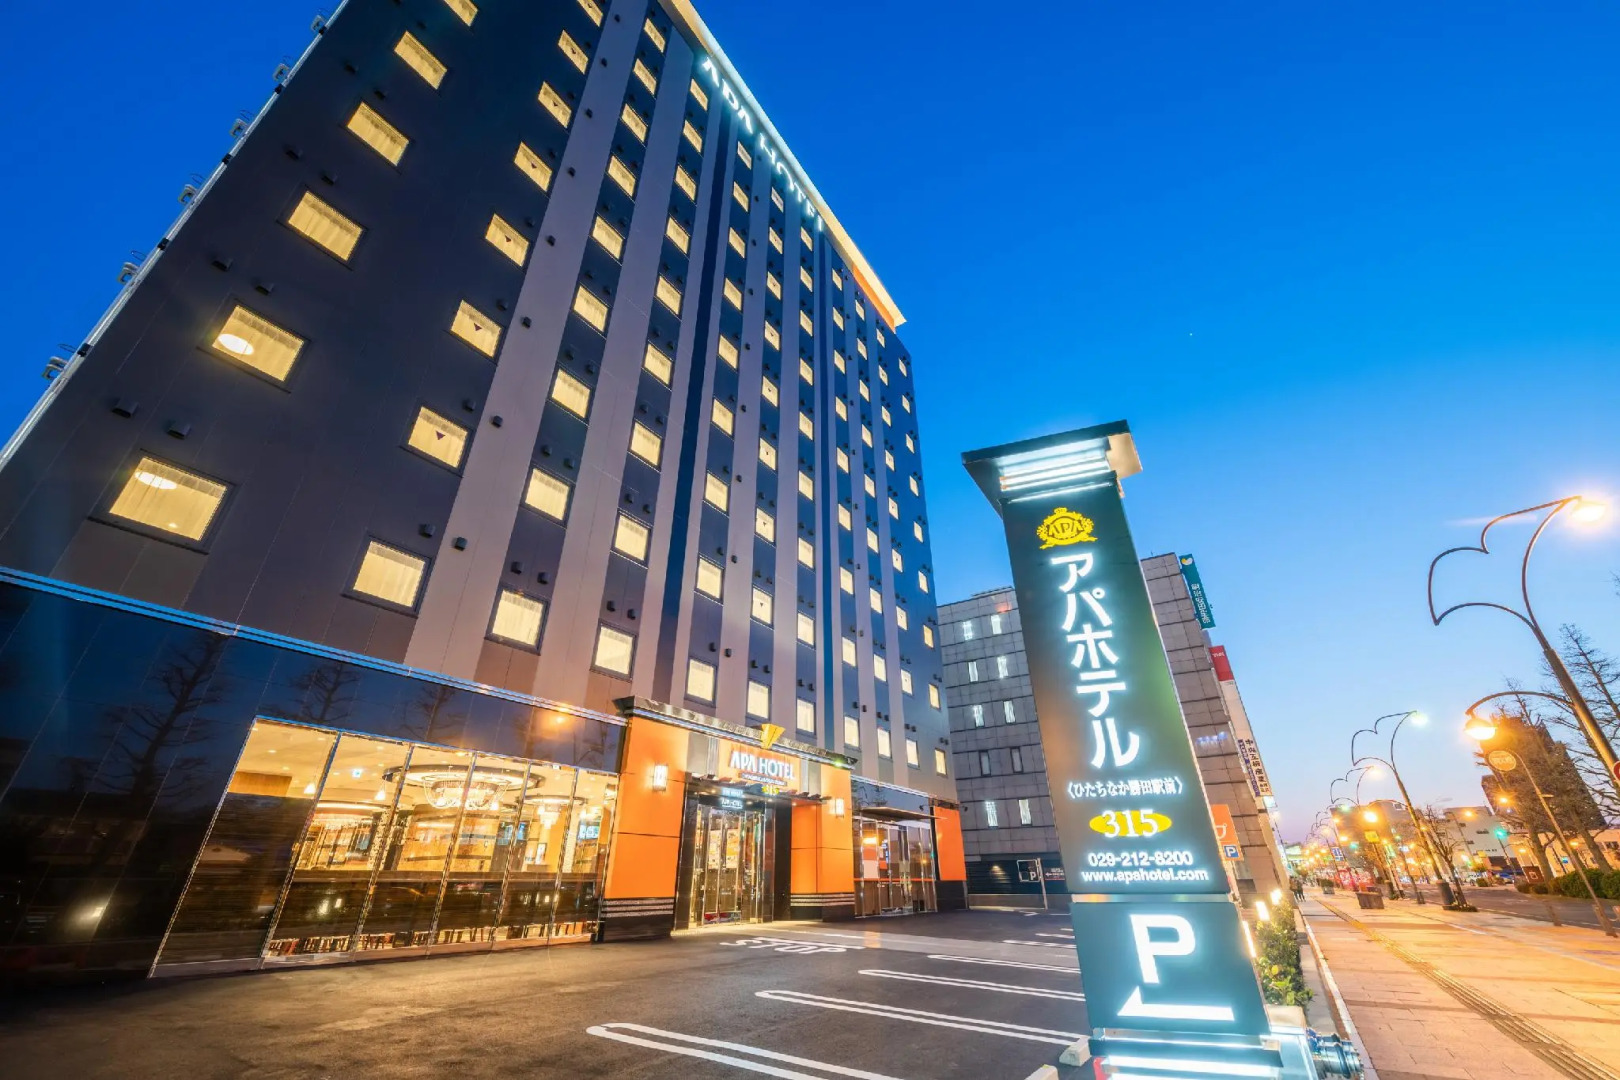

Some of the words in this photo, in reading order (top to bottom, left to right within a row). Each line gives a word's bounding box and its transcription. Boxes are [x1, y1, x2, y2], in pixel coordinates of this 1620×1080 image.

[1051, 552, 1140, 769] アパホテル
[730, 750, 758, 773] APA
[759, 757, 794, 779] HOTEL
[1101, 808, 1158, 838] 315
[1087, 850, 1193, 867] 029-212-8200
[1080, 868, 1209, 885] www.apahotel.com
[1130, 914, 1196, 984] P
